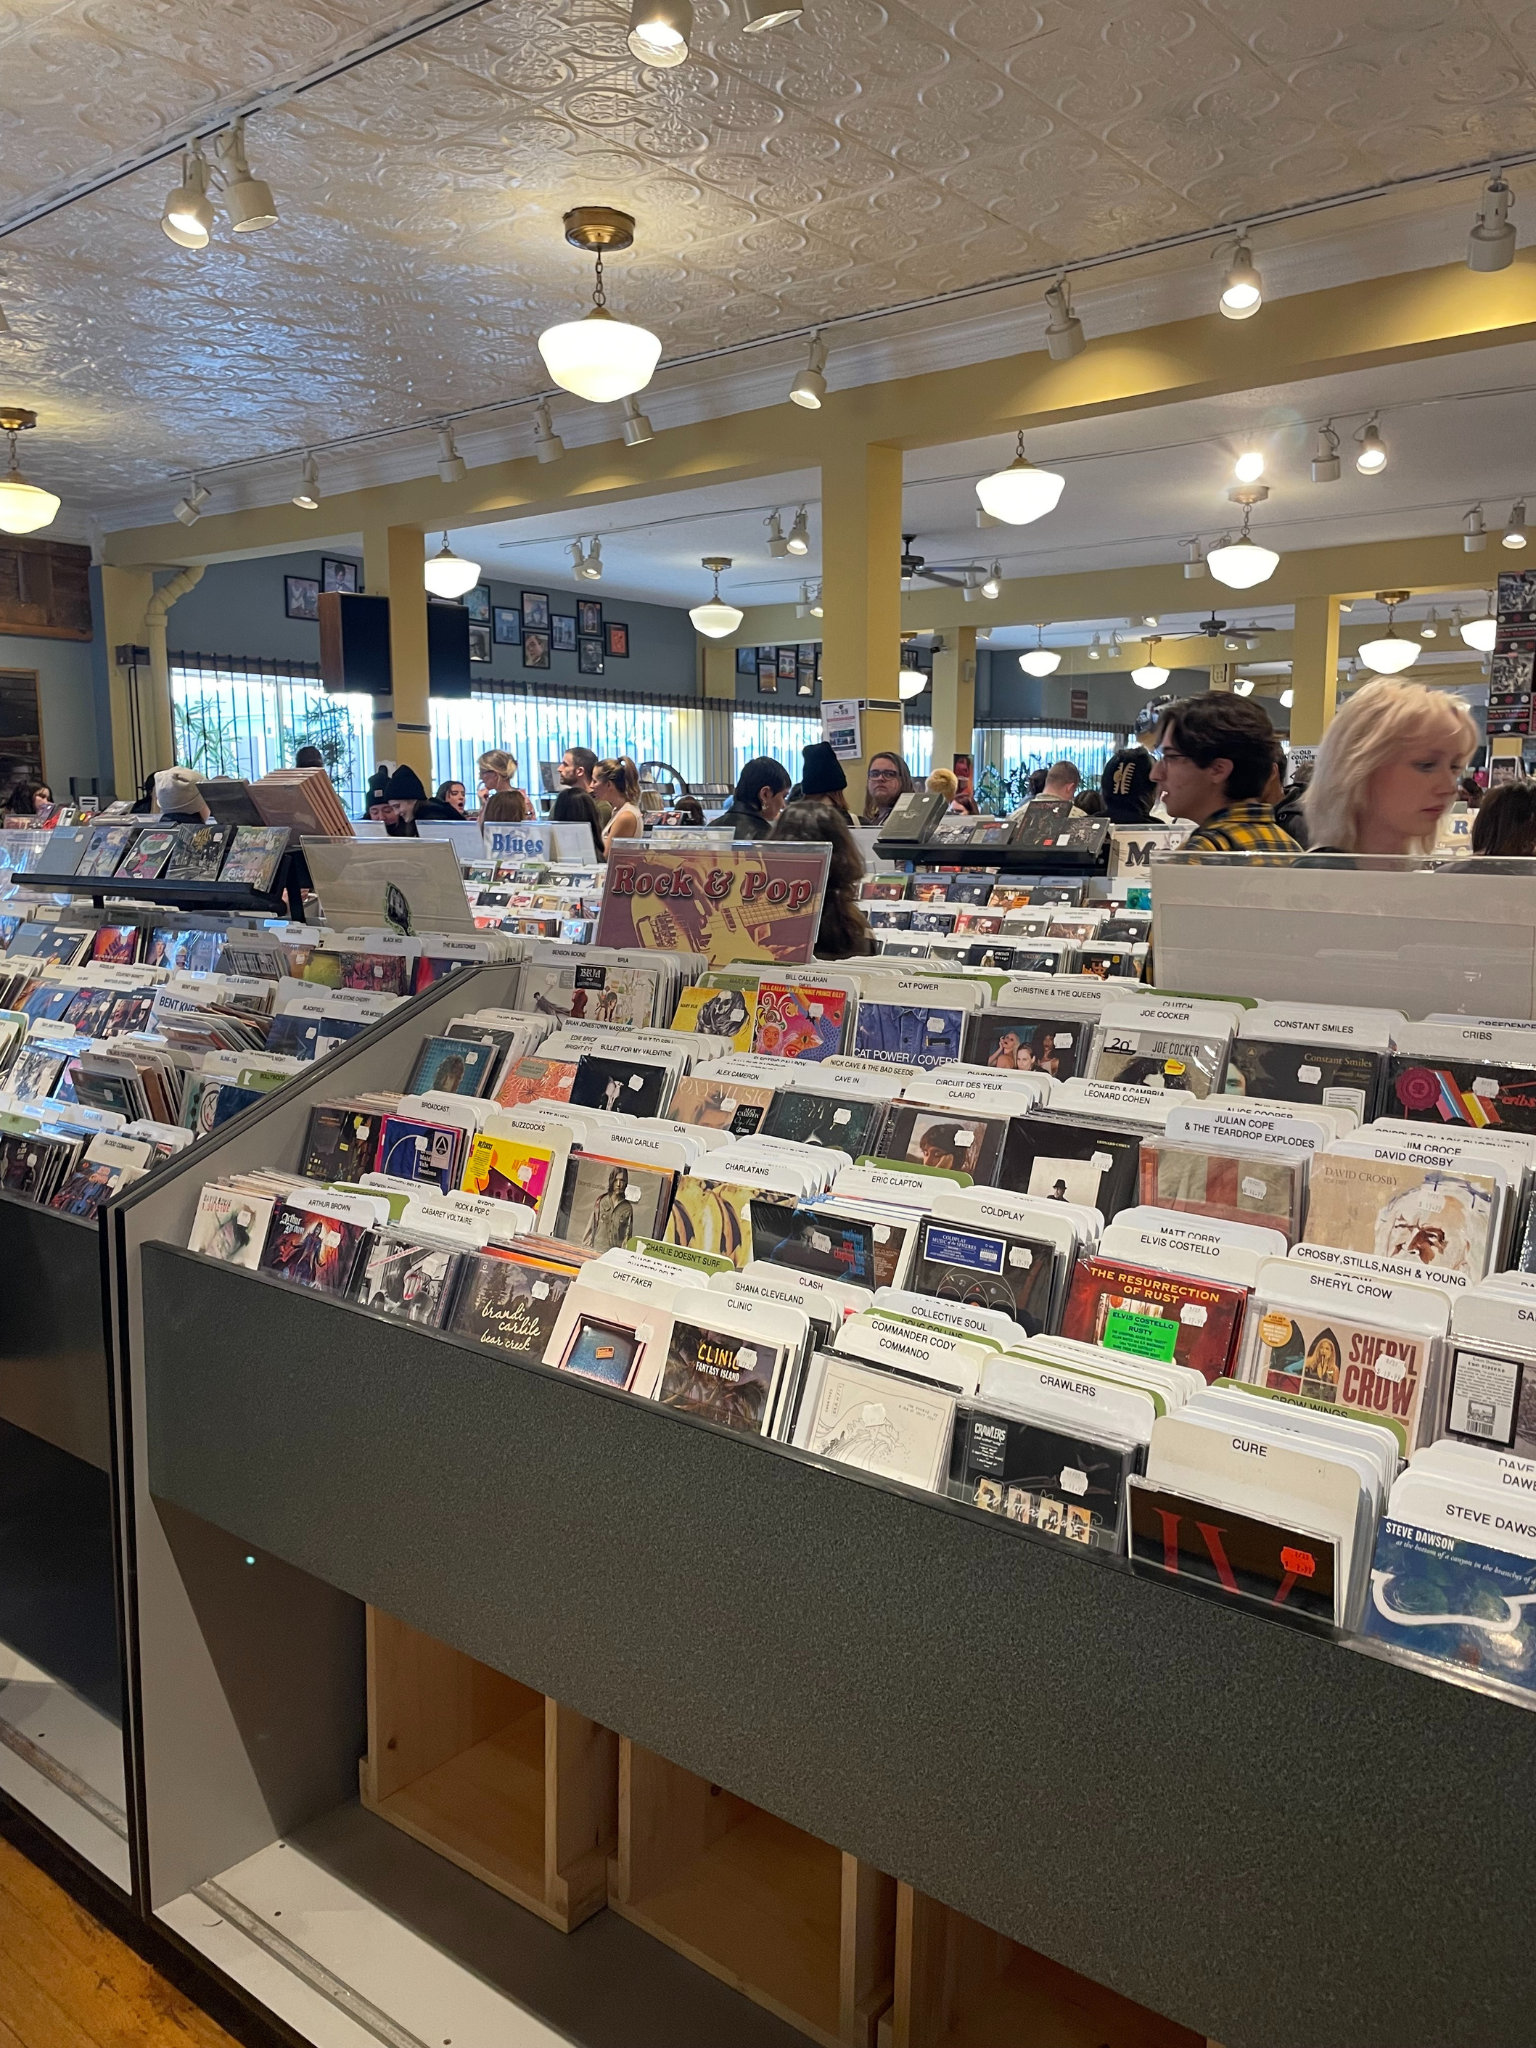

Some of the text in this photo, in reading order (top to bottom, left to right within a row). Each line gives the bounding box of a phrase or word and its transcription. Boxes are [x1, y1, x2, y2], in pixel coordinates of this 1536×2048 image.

[492, 833, 544, 854] Blues
[611, 864, 813, 910] Rock & Pop
[798, 974, 828, 983] CALLAHAN
[913, 982, 939, 990] POWER
[832, 991, 844, 999] BILLY
[1013, 986, 1049, 996] CHRISTINE
[1072, 990, 1101, 1000] QUEENS
[160, 996, 180, 1010] BENT
[1140, 1010, 1190, 1020] JOE COCKER
[579, 1022, 608, 1030] JONESTOWN
[1274, 1020, 1354, 1034] CONSTANT SMILES
[1462, 1030, 1492, 1040] CRIBS
[600, 1044, 619, 1052] BULLET
[643, 1048, 672, 1058] VALENTINE
[854, 1048, 872, 1060] CAT
[872, 1049, 909, 1064] POWER
[918, 1054, 959, 1067] COVERS
[1152, 1042, 1167, 1053] JOE
[1168, 1042, 1200, 1057] COCKER
[830, 1060, 844, 1068] NICK
[844, 1061, 861, 1070] CAVE
[880, 1066, 891, 1074] BAD
[893, 1068, 914, 1076] SEEDS
[1304, 1053, 1372, 1068] Constant Smiles
[716, 1069, 760, 1080] ALEX CAMERON
[680, 1080, 772, 1106] OXY MUSIC
[936, 1078, 1002, 1091] CIRCUIT DES YEUX
[948, 1090, 976, 1100] CLAIRO
[1084, 1090, 1150, 1105] LEONARD COHEN
[421, 1102, 450, 1113] BROADCAST
[512, 1120, 546, 1132] BUZZCOCKS
[674, 1126, 686, 1134] CAN
[1214, 1115, 1275, 1130] JULIAN COPE
[611, 1134, 660, 1150] BRANDI CARLILE
[1184, 1122, 1316, 1149] & THE TEARDROP EXPLODES
[1374, 1149, 1454, 1168] DAVID CROSBY
[725, 1162, 770, 1176] CHARLATANS
[1324, 1166, 1398, 1186] DAVID CROSBY
[872, 1175, 923, 1189] ERIC CLAPTON
[308, 1200, 351, 1212] ARTHUR BROWN
[454, 1202, 469, 1212] ROCK
[474, 1206, 486, 1214] POP
[980, 1206, 1025, 1222] COLDPLAY
[422, 1207, 472, 1226] CABARET VOLTAIRE
[942, 1234, 966, 1244] COLDPLAY
[1160, 1227, 1186, 1238] MATT
[932, 1237, 976, 1250] MUSIC SPHERES
[1140, 1234, 1220, 1256] ELVIS COSTELLO
[646, 1242, 721, 1268] CHARLIE DOESN'T SURF
[612, 1271, 652, 1289] CHET FAKER
[799, 1276, 824, 1291] CLASH
[1090, 1267, 1220, 1303] THE RESURRECTION
[1414, 1270, 1467, 1287] & YOUNG
[736, 1282, 804, 1305] SHANA CLEVELAND
[1123, 1286, 1180, 1304] OF RUST
[1310, 1275, 1392, 1300] SHERYL CROW
[481, 1299, 526, 1322] brandi
[727, 1299, 753, 1312] CLINIC
[498, 1315, 542, 1336] carlile
[912, 1306, 988, 1332] COLLECTIVE SOUL
[1112, 1312, 1174, 1330] ELVIS COSTELLO
[871, 1320, 956, 1352] COMMANDER CODY
[1128, 1326, 1153, 1336] RUSTY
[480, 1328, 531, 1352] bear creek
[698, 1343, 740, 1370] CLINIC
[879, 1338, 930, 1361] COMMANDO
[1349, 1332, 1418, 1376] SHERYL
[696, 1362, 740, 1382] FANTASY ISLAND
[1040, 1374, 1096, 1397] CRAWLERS
[1342, 1364, 1416, 1417] CROW
[1271, 1394, 1348, 1419] CROW WINGS
[974, 1422, 1006, 1442] CRAWLERS
[1232, 1438, 1268, 1458] CURE
[1446, 1504, 1492, 1526] STEVE
[1386, 1522, 1455, 1552] STEVE DAWSON
[1404, 1540, 1414, 1549] the
[1414, 1543, 1436, 1556] bottom
[1438, 1552, 1445, 1560] of
[1450, 1556, 1472, 1566] canyon
[1482, 1564, 1493, 1572] the
[1494, 1566, 1522, 1580] branches
[1523, 1575, 1532, 1584] of
